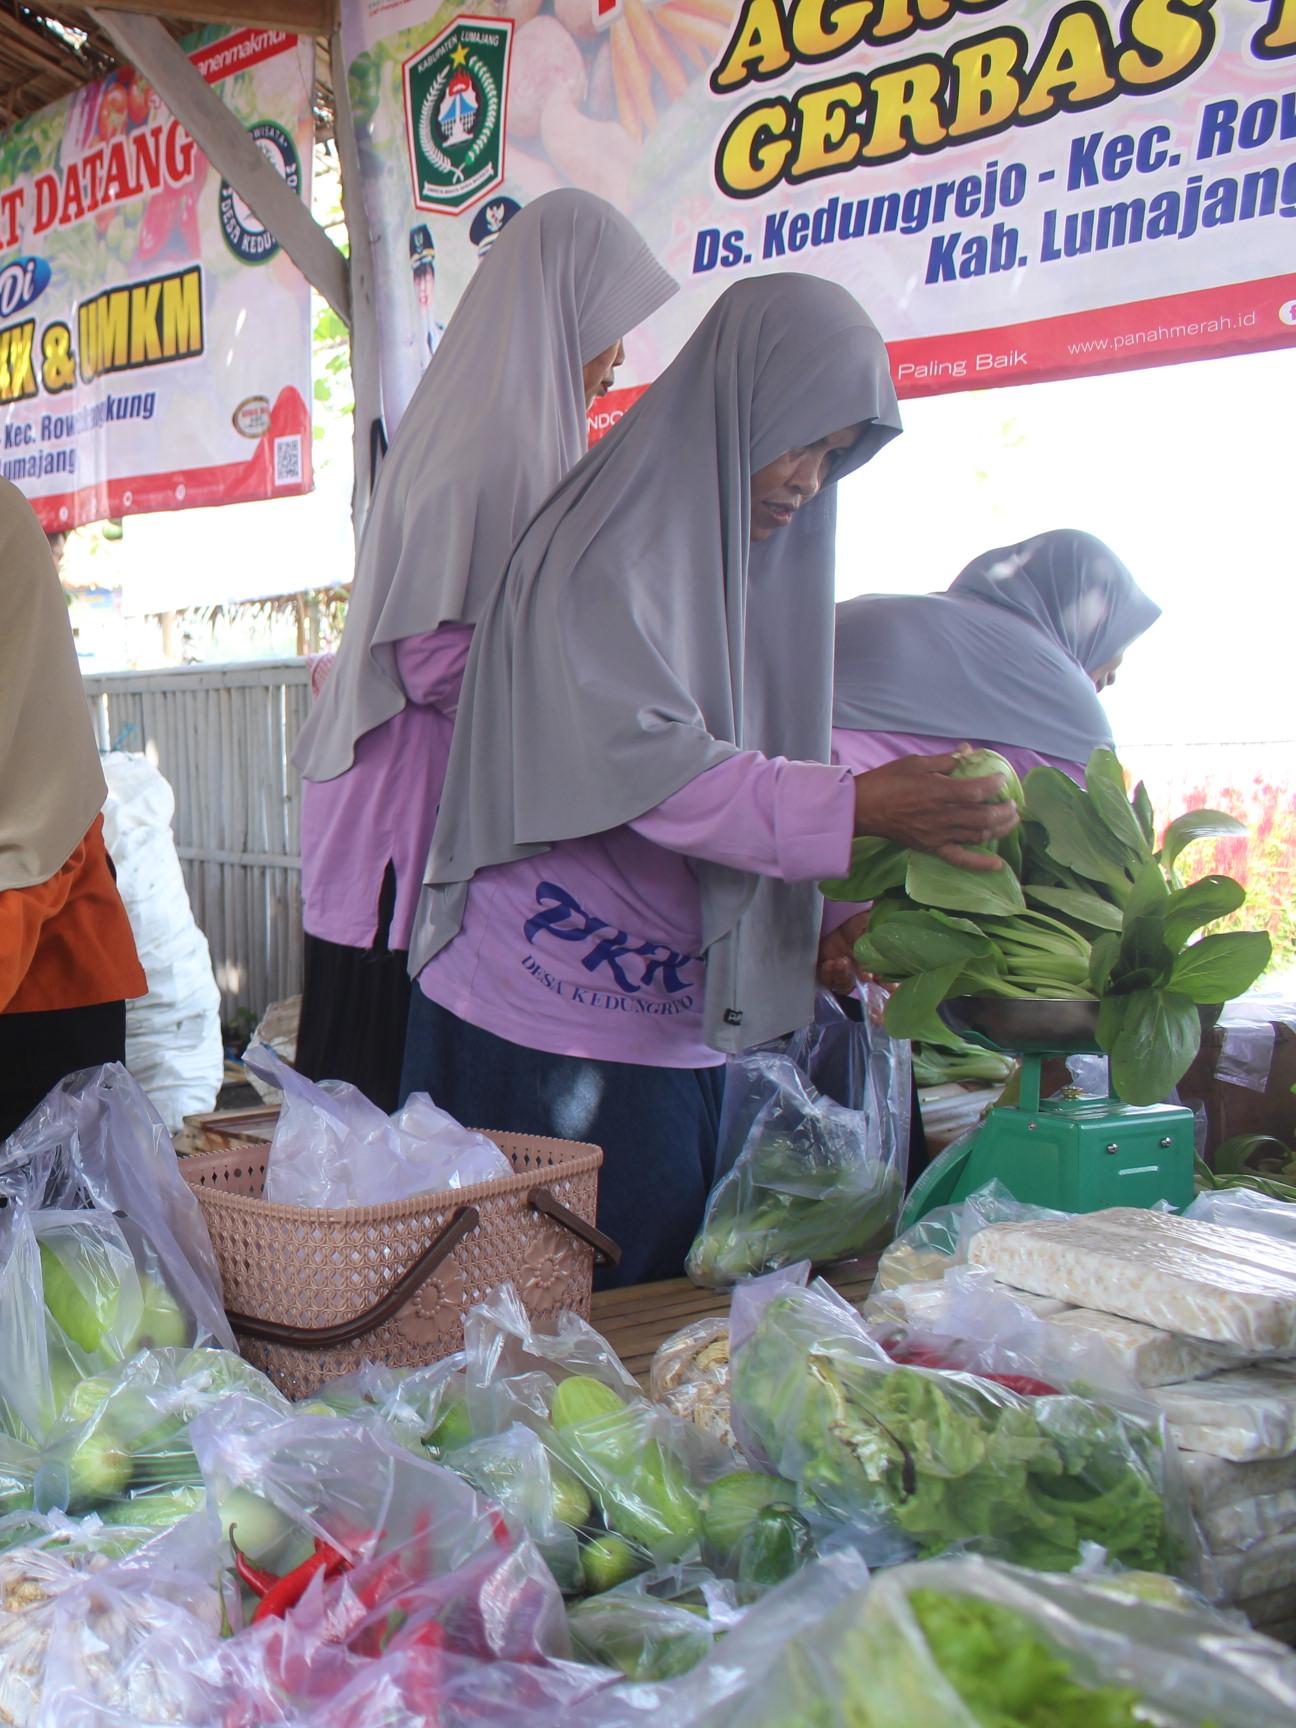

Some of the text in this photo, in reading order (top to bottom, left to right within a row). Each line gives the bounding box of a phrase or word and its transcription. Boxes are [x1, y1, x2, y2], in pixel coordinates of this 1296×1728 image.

[197, 31, 287, 75] anenmakmur
[417, 34, 458, 73] KABUPATEN
[460, 30, 500, 47] LUMAJANG
[714, 0, 1216, 200] GERBAS
[252, 126, 285, 145] WISATA
[32, 119, 195, 235] DATANG
[692, 228, 752, 275] Ds.
[762, 160, 1027, 260] Kedungrejo
[1038, 169, 1055, 182] -
[1067, 126, 1181, 192] Kec.
[221, 199, 276, 254] DESA KEDU
[925, 221, 1027, 285] Kab.
[42, 321, 76, 393] &
[78, 264, 204, 385] UMKM
[1067, 311, 1257, 356] www.panahmerah.id
[898, 350, 1028, 381] Paling Baik
[4, 421, 37, 449] Kec.
[520, 954, 565, 996] DESA
